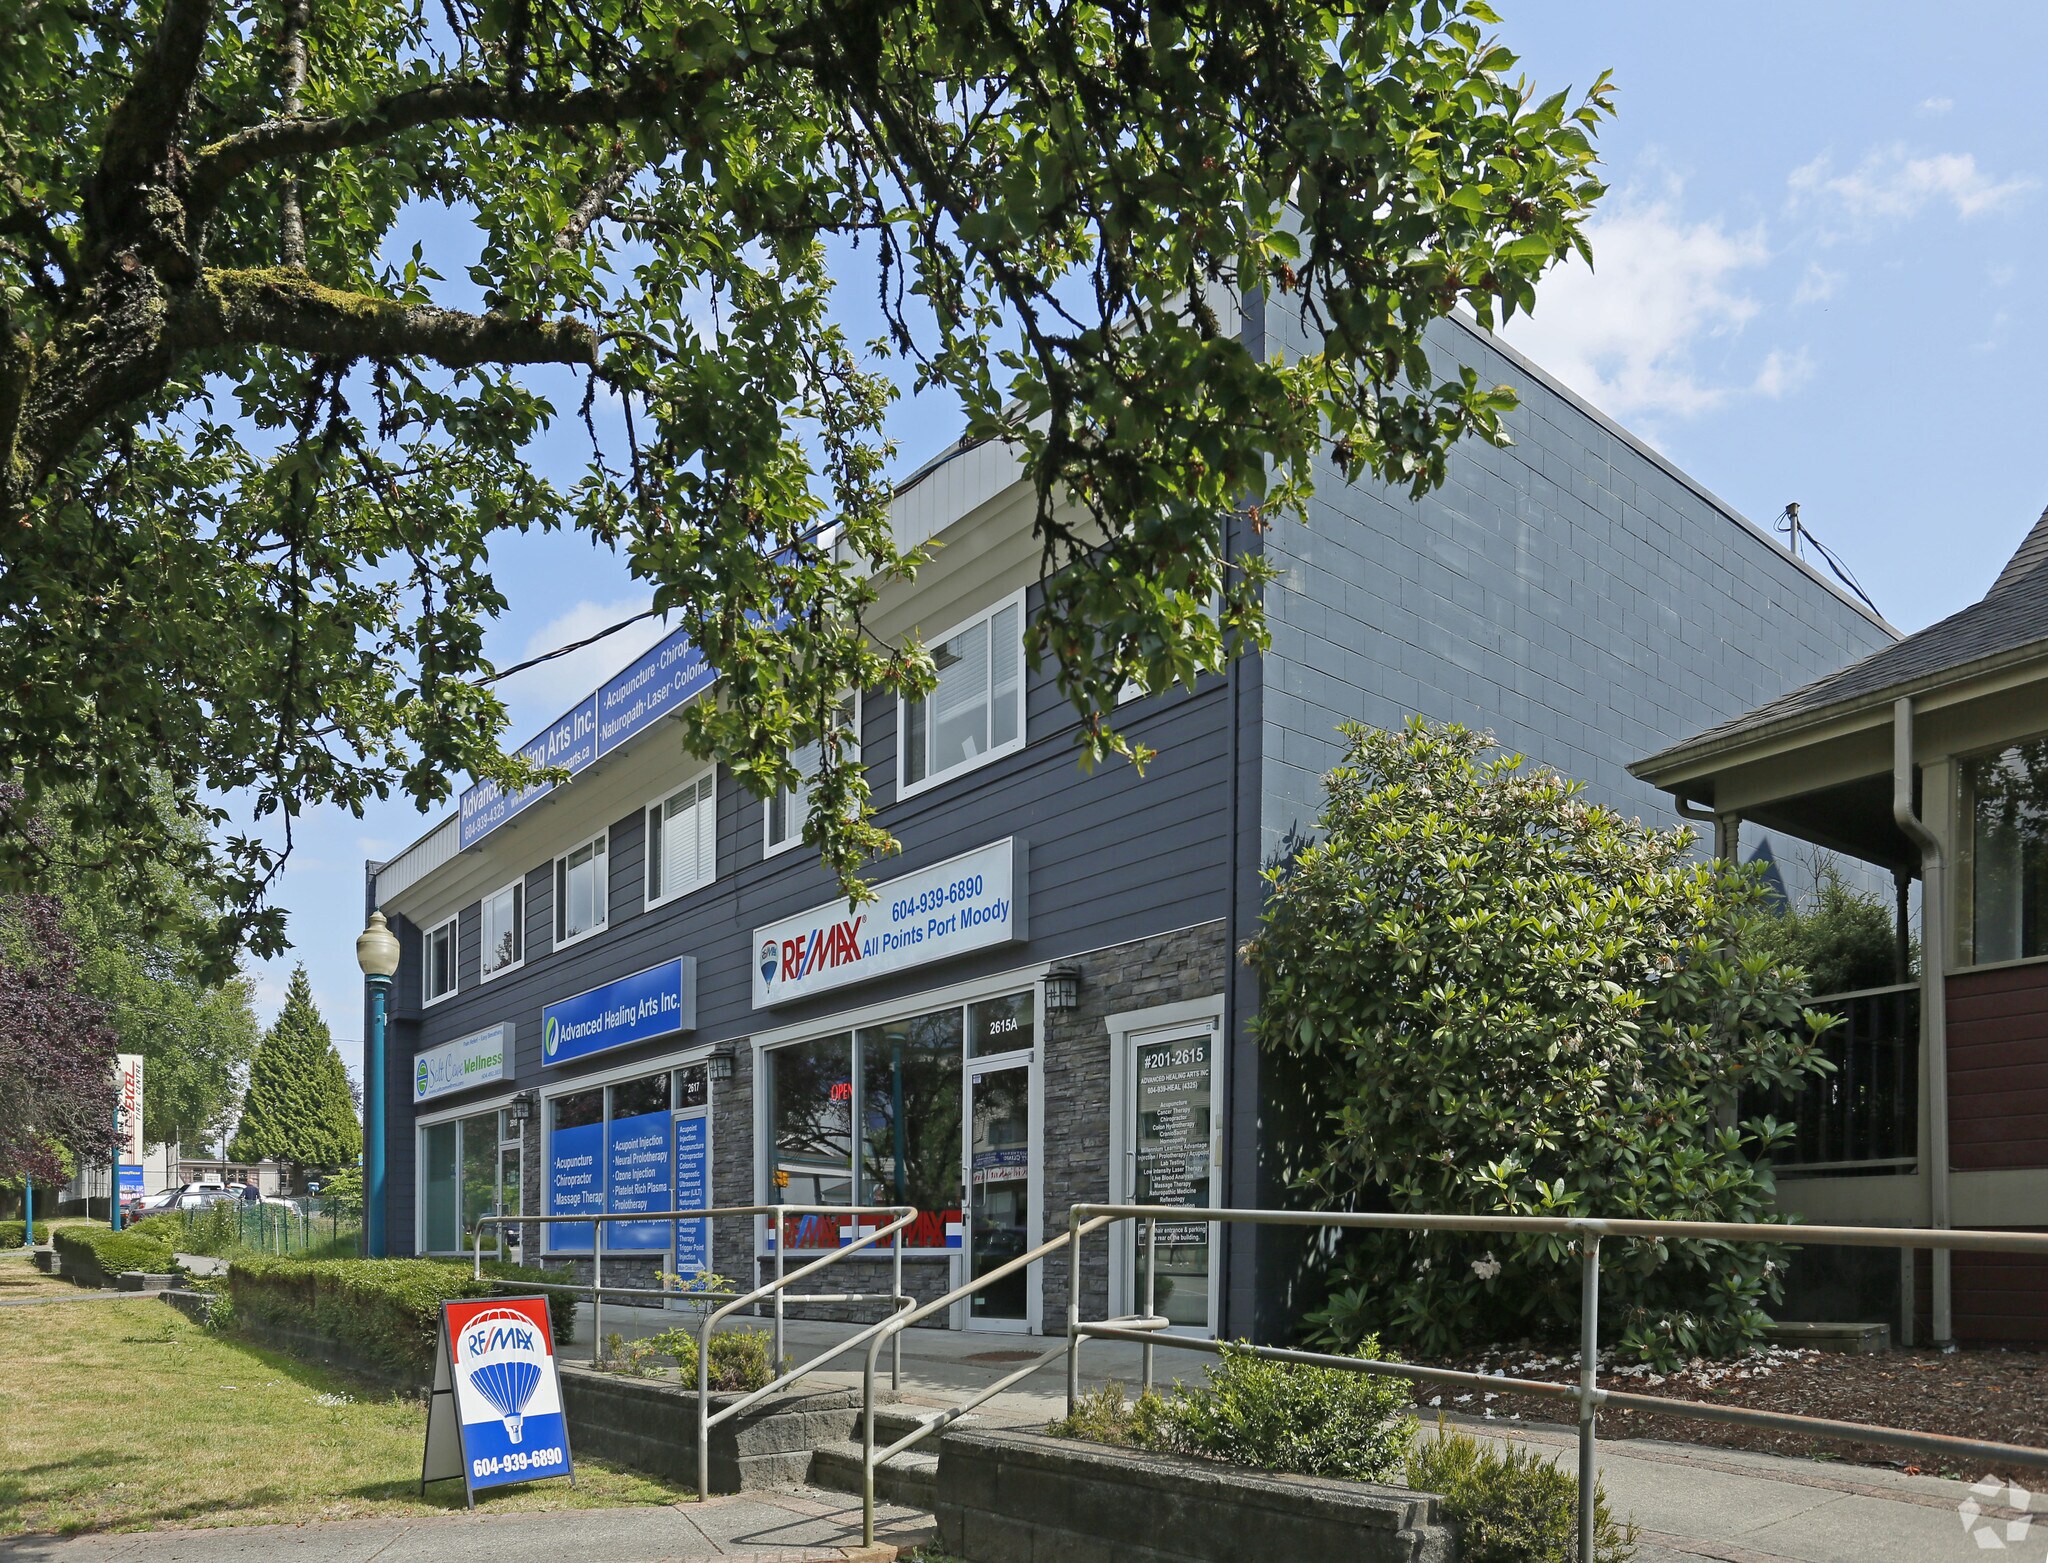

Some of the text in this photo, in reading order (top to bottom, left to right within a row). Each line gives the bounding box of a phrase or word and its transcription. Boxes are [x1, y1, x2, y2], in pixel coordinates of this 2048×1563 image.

[605, 639, 690, 710] Acupuncture Chirop
[601, 699, 644, 742] Naturopath
[646, 683, 671, 711] Laser
[461, 778, 504, 823] Advance
[547, 724, 571, 760] Arts
[574, 710, 595, 742] Inc.
[464, 801, 505, 840] 604-939-4325
[892, 874, 983, 922] 604-939-6890
[863, 938, 879, 959] All
[883, 927, 923, 953] Points
[928, 916, 956, 940] Port
[960, 899, 1010, 930] Moody
[560, 992, 680, 1043] Advanced Healing Arts Inc.
[990, 1018, 1018, 1035] 2615A
[464, 1052, 503, 1074] Wellness
[1144, 1047, 1203, 1069] #201-2615
[1141, 1075, 1165, 1084] ADVANCED
[1166, 1072, 1186, 1081] HEALING
[1187, 1070, 1200, 1078] ARTS
[124, 1060, 135, 1112] EXCEL
[688, 1082, 699, 1093] 2617
[1160, 1115, 1187, 1123] Chiropractor
[1166, 1121, 1195, 1130] Hydrotherapy
[679, 1124, 697, 1133] Acupoint
[615, 1135, 662, 1152] Acupoint Injection
[679, 1135, 696, 1143] Injection
[679, 1143, 704, 1152] Acupuncture
[556, 1154, 593, 1171] Acupuncture
[615, 1150, 668, 1166] Neural Prolotherapy
[679, 1152, 704, 1161] Chiropractor
[679, 1162, 697, 1170] Colonics
[556, 1172, 593, 1188] Chiropractor
[615, 1167, 656, 1181] Ozone Injection
[679, 1170, 700, 1179] Diagnostic
[615, 1182, 667, 1196] Platelet Rich Plasma
[556, 1192, 581, 1207] Massage
[615, 1198, 647, 1211] Prolotherapy
[1188, 1226, 1206, 1234] parking
[679, 1235, 695, 1243] Therapy
[693, 1243, 704, 1251] Point
[468, 1326, 535, 1358] RE/MAX
[473, 1446, 562, 1478] 604-939-6890
